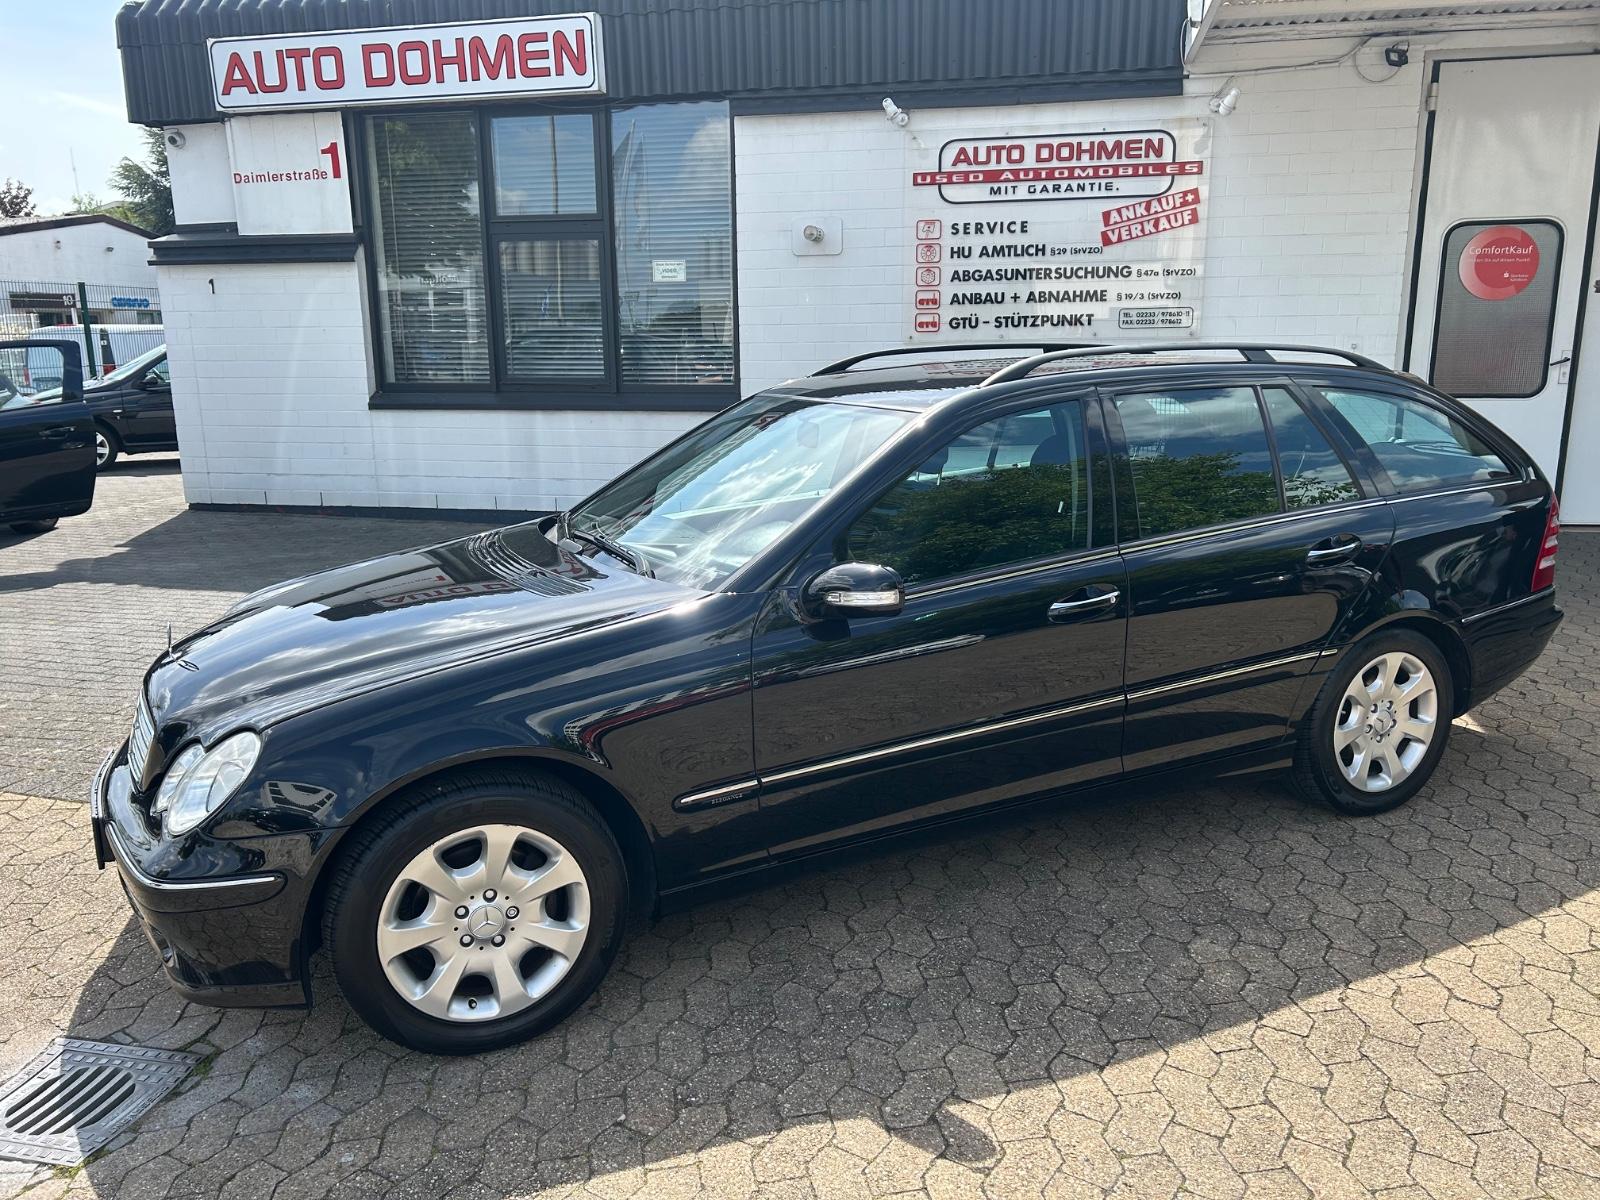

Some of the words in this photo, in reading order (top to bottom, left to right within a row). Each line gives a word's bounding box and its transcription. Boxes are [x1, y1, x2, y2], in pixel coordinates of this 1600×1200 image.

[221, 46, 345, 96] AUTO
[361, 29, 588, 88] DOHMEN
[952, 144, 1025, 166] AUTO
[1035, 138, 1164, 163] DOHMEN
[234, 168, 328, 184] Daimlerstraße
[320, 142, 342, 179] 1
[917, 172, 984, 184] USED
[1000, 163, 1199, 181] AUTOMOBILES
[989, 185, 1019, 196] MIT
[1027, 182, 1119, 194] GARANTIE.
[951, 221, 1029, 236] SERVICE
[1107, 210, 1193, 243] VERKAUF
[950, 246, 972, 259] HU
[978, 243, 1046, 258] AMTLICH
[1070, 246, 1103, 256] (StVZO)
[1469, 245, 1534, 254] ComfortKauf
[950, 265, 1132, 283] ABGASUNTERSUCHUNG
[1162, 267, 1196, 277] (StVZO)
[950, 292, 1005, 305] ANBAU
[1026, 289, 1107, 304] ABNAHME
[1147, 290, 1182, 301] (StVZO)
[949, 314, 979, 330] GTÜ
[993, 313, 1094, 328] STÜTZPUNKT
